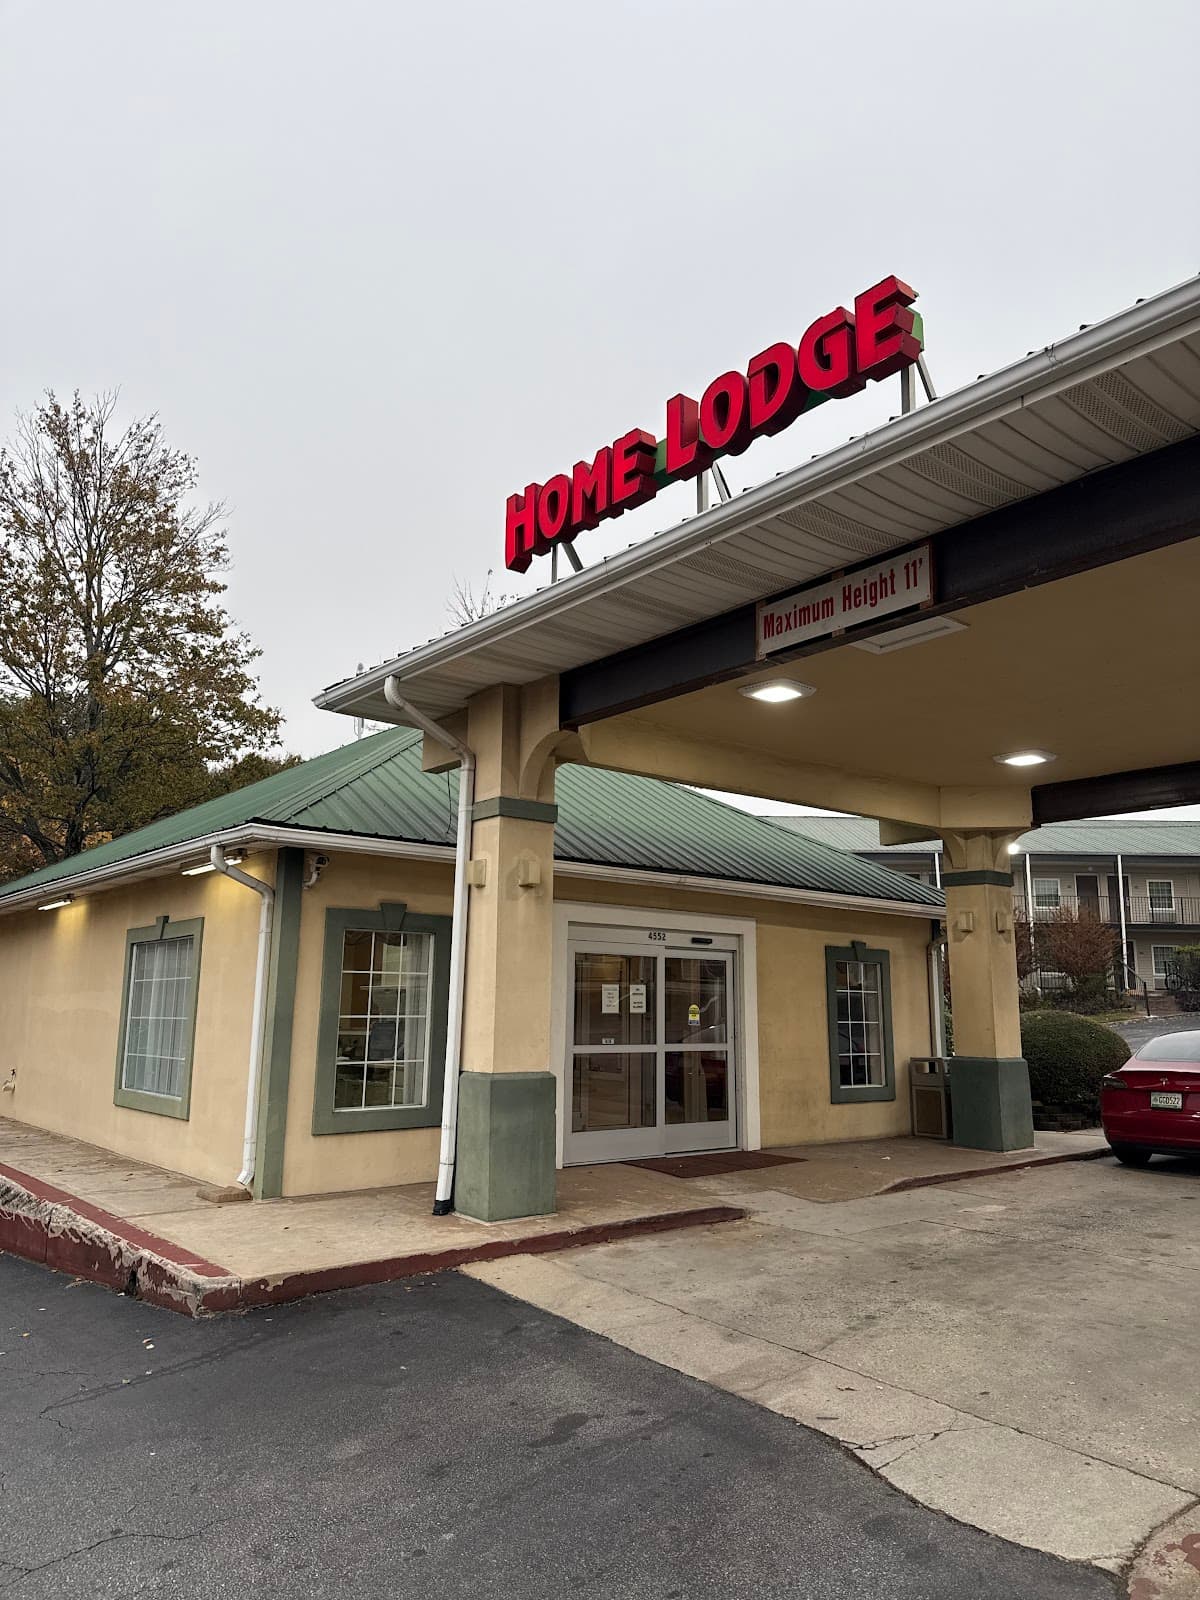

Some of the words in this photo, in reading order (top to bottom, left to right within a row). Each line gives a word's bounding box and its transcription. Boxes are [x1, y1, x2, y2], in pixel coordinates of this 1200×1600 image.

[505, 428, 657, 574] HOME
[667, 275, 921, 481] LODGE
[763, 597, 835, 640] Maximum
[842, 568, 896, 612] Height
[648, 931, 666, 941] 4552
